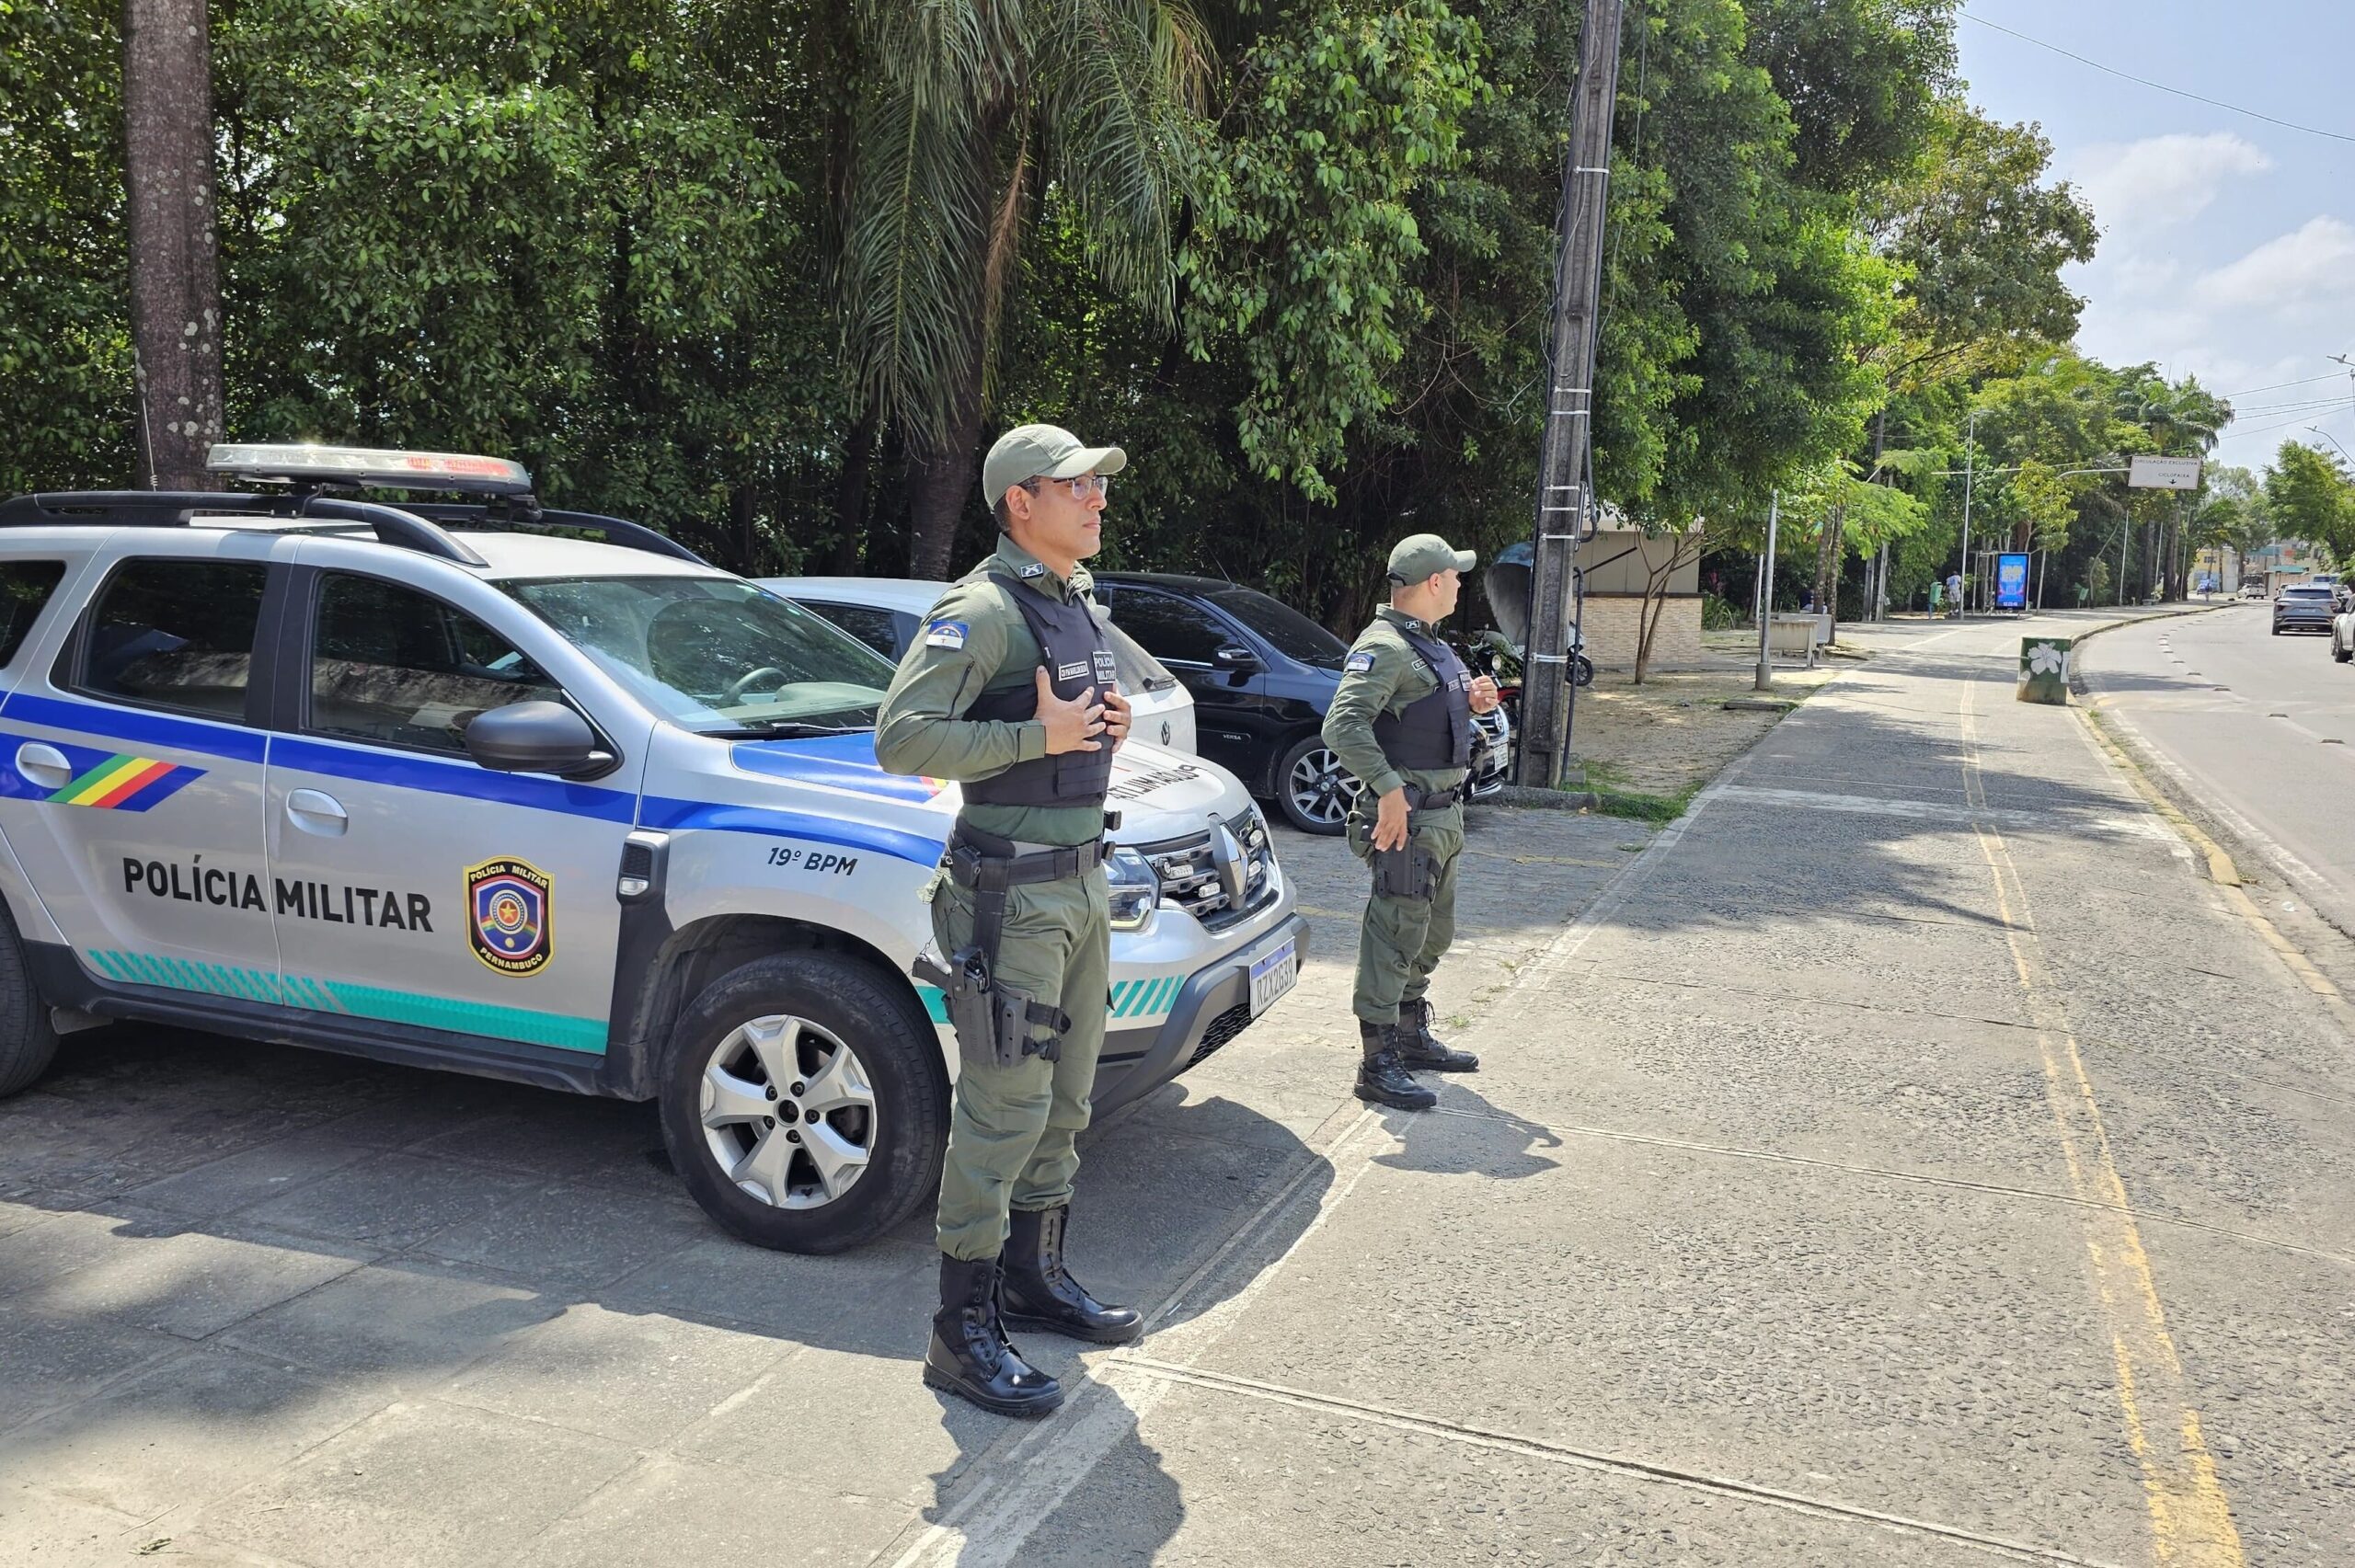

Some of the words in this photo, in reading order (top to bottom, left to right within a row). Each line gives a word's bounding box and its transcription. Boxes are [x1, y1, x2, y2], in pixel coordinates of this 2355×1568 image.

[1094, 655, 1114, 668] POLÍCIA
[470, 864, 506, 882] POLÍCIA
[511, 865, 548, 888] MILITAR
[803, 852, 858, 876] BPM
[123, 853, 267, 912] POLÍCIA
[275, 877, 434, 933] MILITAR
[479, 946, 543, 970] PERNAMBUCO
[1257, 956, 1293, 1008] RZX2G39
